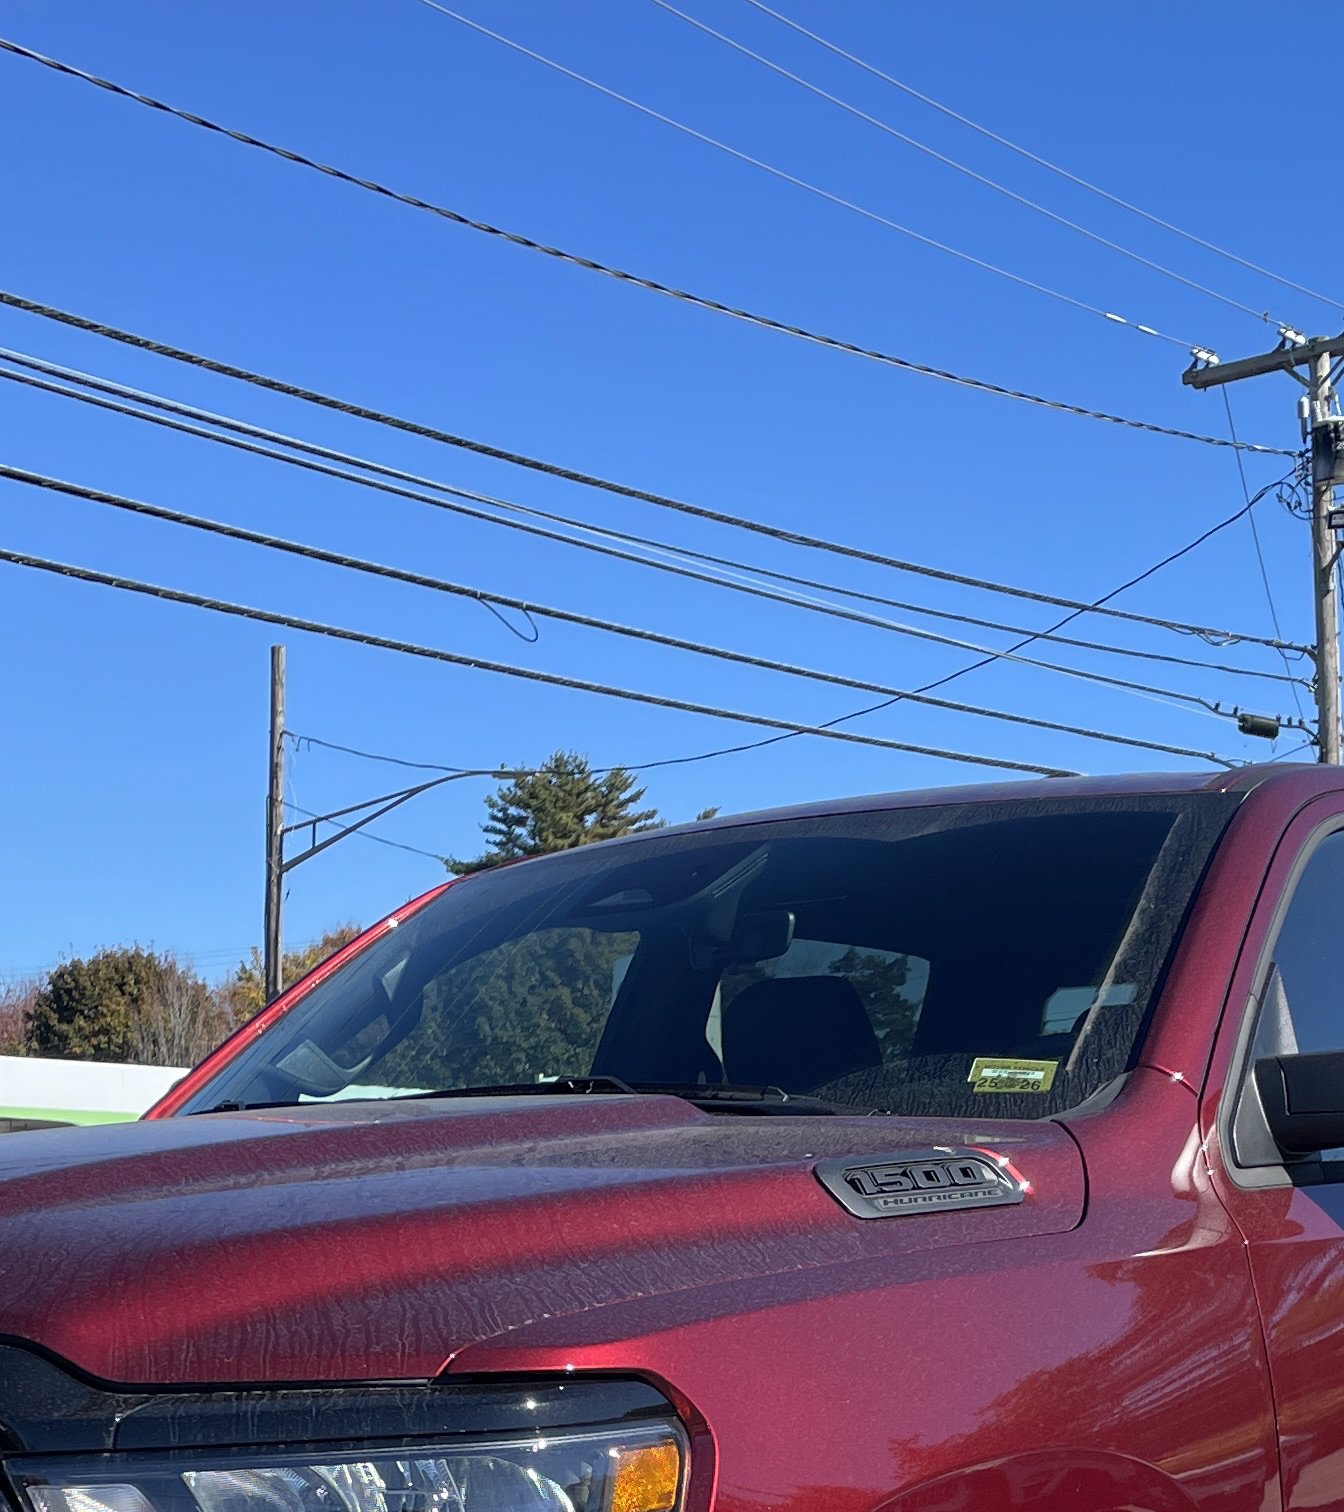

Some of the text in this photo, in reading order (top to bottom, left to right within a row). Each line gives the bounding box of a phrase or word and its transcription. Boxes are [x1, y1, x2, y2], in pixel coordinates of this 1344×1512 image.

[976, 1077, 998, 1088] 25
[1018, 1080, 1042, 1091] 26
[846, 1162, 986, 1196] 1500
[883, 1188, 1002, 1206] HURRICANE
